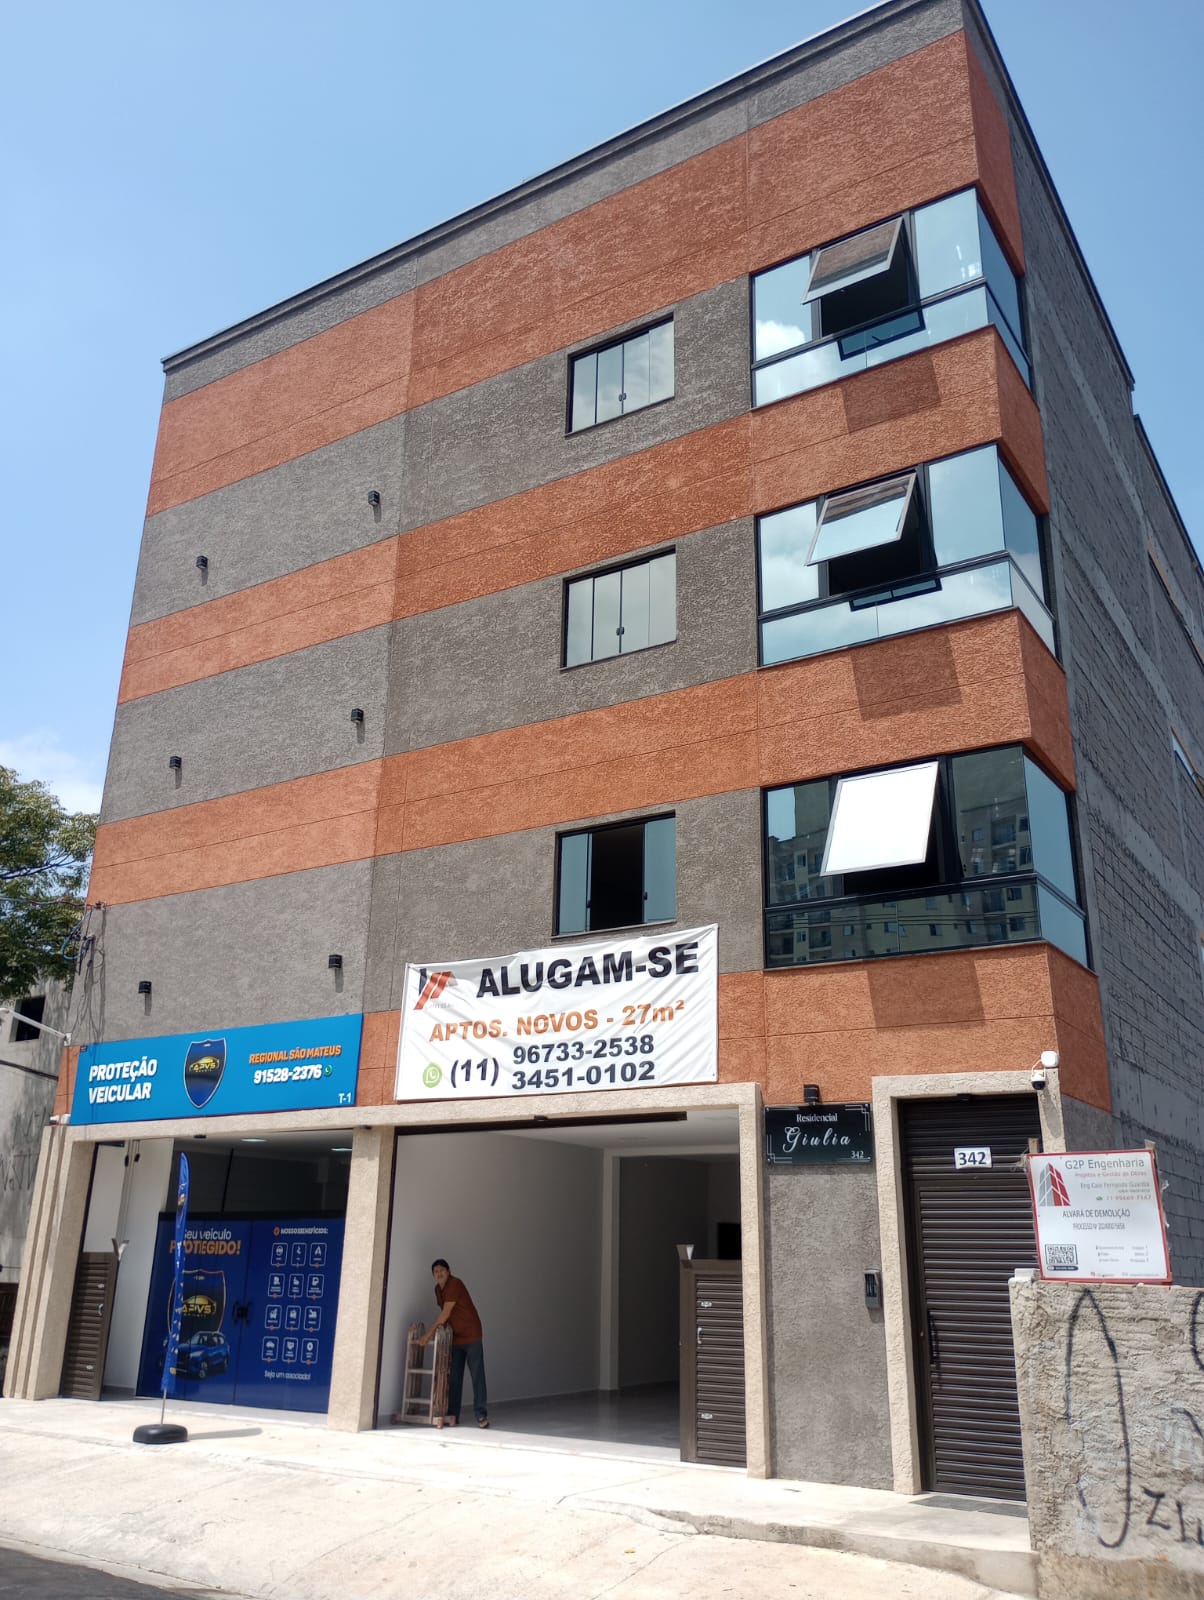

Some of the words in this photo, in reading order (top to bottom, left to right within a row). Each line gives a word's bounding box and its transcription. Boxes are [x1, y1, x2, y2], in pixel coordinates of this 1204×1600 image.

[476, 942, 699, 998] ALUGAM-SE
[429, 1019, 508, 1042] APTOS.
[517, 1008, 598, 1036] NOVOS
[249, 1050, 288, 1064] REGIONAL
[289, 1046, 307, 1059] SÃO
[307, 1044, 342, 1057] MATEUS
[513, 1034, 654, 1065] 96733-2538
[89, 1056, 157, 1083] PROTEÇÃO
[253, 1064, 322, 1085] 91528-2376
[450, 1057, 500, 1088] (11)
[512, 1060, 655, 1089] 3451-0102
[88, 1082, 152, 1104] VEICULAR
[796, 1113, 838, 1123] Residencial
[783, 1127, 851, 1153] Giulia
[851, 1150, 864, 1159] 342
[958, 1151, 987, 1166] 342
[1065, 1160, 1085, 1170] G2P
[1088, 1158, 1145, 1171] Engenharia
[1085, 1209, 1095, 1217] DE
[169, 1240, 241, 1255] POTEGIDO!
